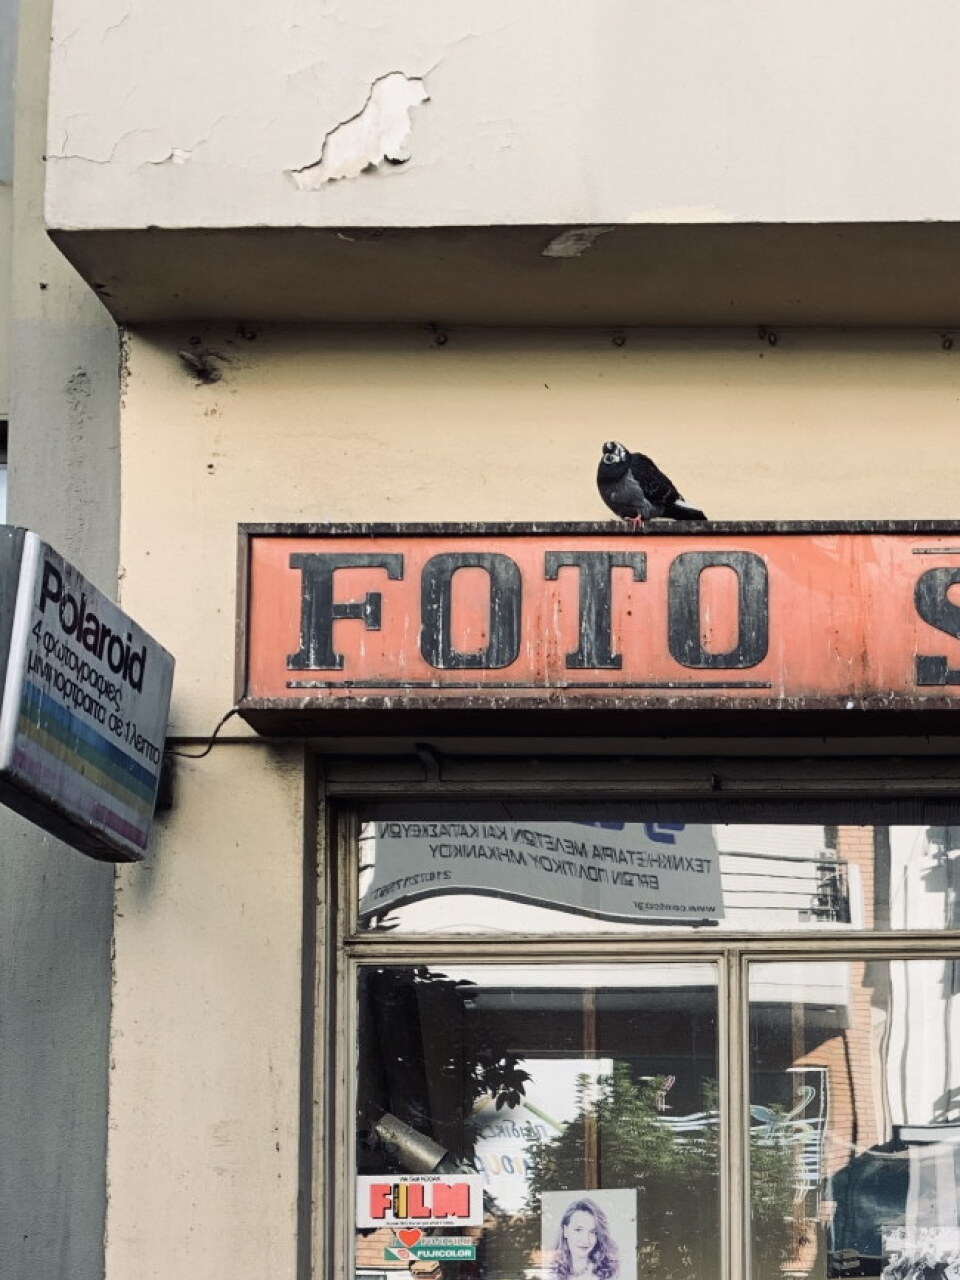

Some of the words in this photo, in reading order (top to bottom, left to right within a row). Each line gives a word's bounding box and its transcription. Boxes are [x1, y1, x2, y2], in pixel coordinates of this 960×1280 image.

[39, 559, 147, 694] Polaroid
[287, 551, 769, 670] FOTO
[32, 619, 42, 643] 4
[369, 1183, 471, 1219] FILM
[417, 1250, 472, 1258] FUJICOLOR
